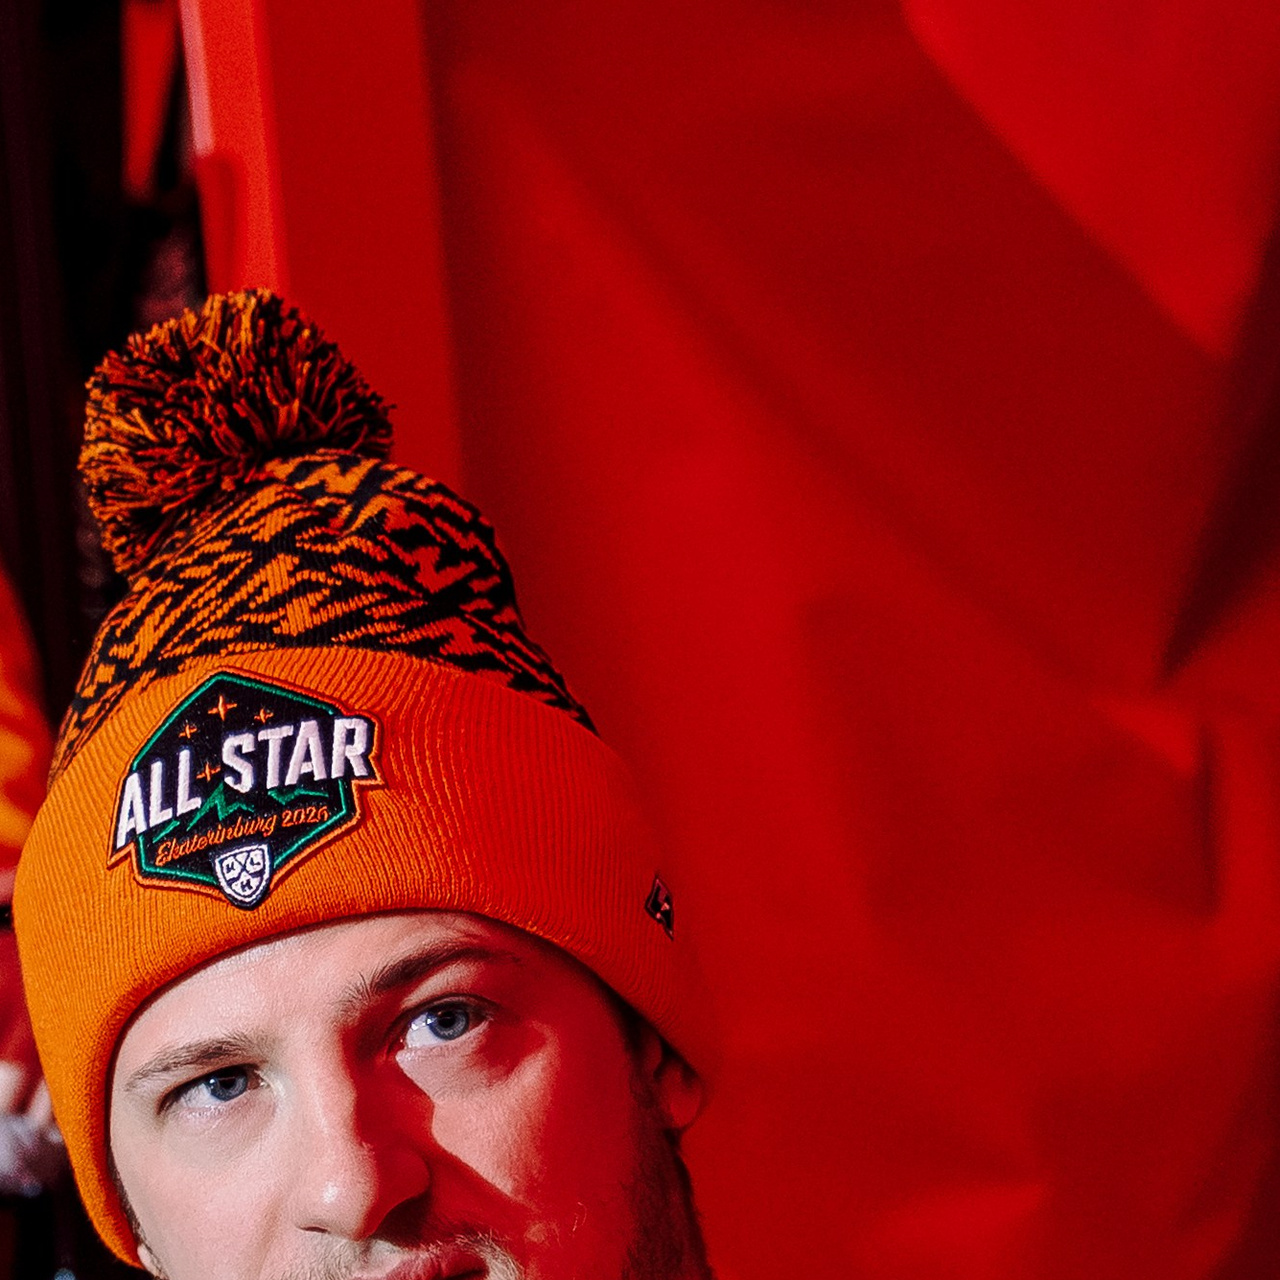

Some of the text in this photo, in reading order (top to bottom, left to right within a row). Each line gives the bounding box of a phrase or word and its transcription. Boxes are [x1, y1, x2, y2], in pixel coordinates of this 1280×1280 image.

[116, 718, 369, 849] ALL STAR
[155, 805, 329, 867] Ekaterinburg 2026
